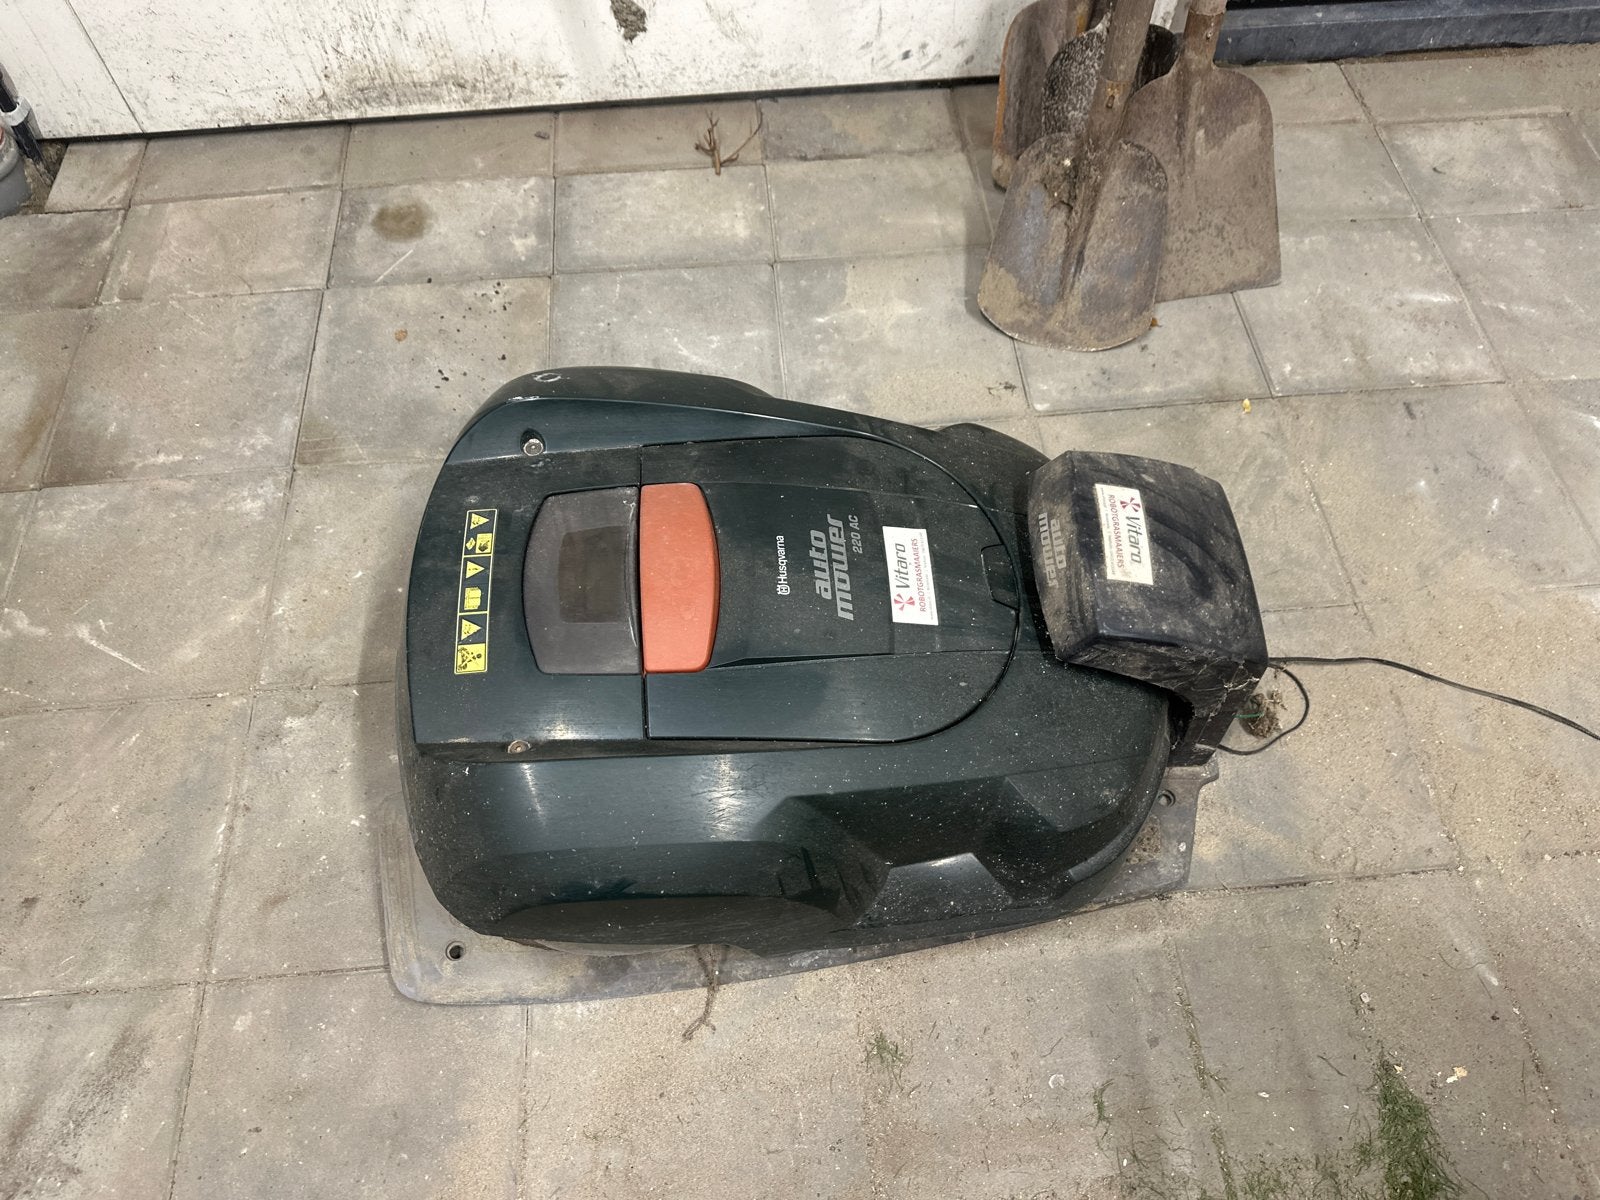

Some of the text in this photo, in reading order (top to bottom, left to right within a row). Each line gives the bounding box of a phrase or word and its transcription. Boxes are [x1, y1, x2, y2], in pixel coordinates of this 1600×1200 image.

[776, 535, 788, 584] Husqvarna
[848, 514, 863, 554] 220 AC
[1038, 512, 1060, 587] mower
[1050, 518, 1067, 570] auto
[1108, 494, 1124, 569] ROBOTGRASMAAIERS
[1125, 516, 1142, 564] Vitaro
[809, 530, 832, 600] auto
[827, 514, 855, 621] mower
[894, 543, 910, 589] Vitaro
[911, 538, 926, 612] ROBOTGRASMAAIERS
